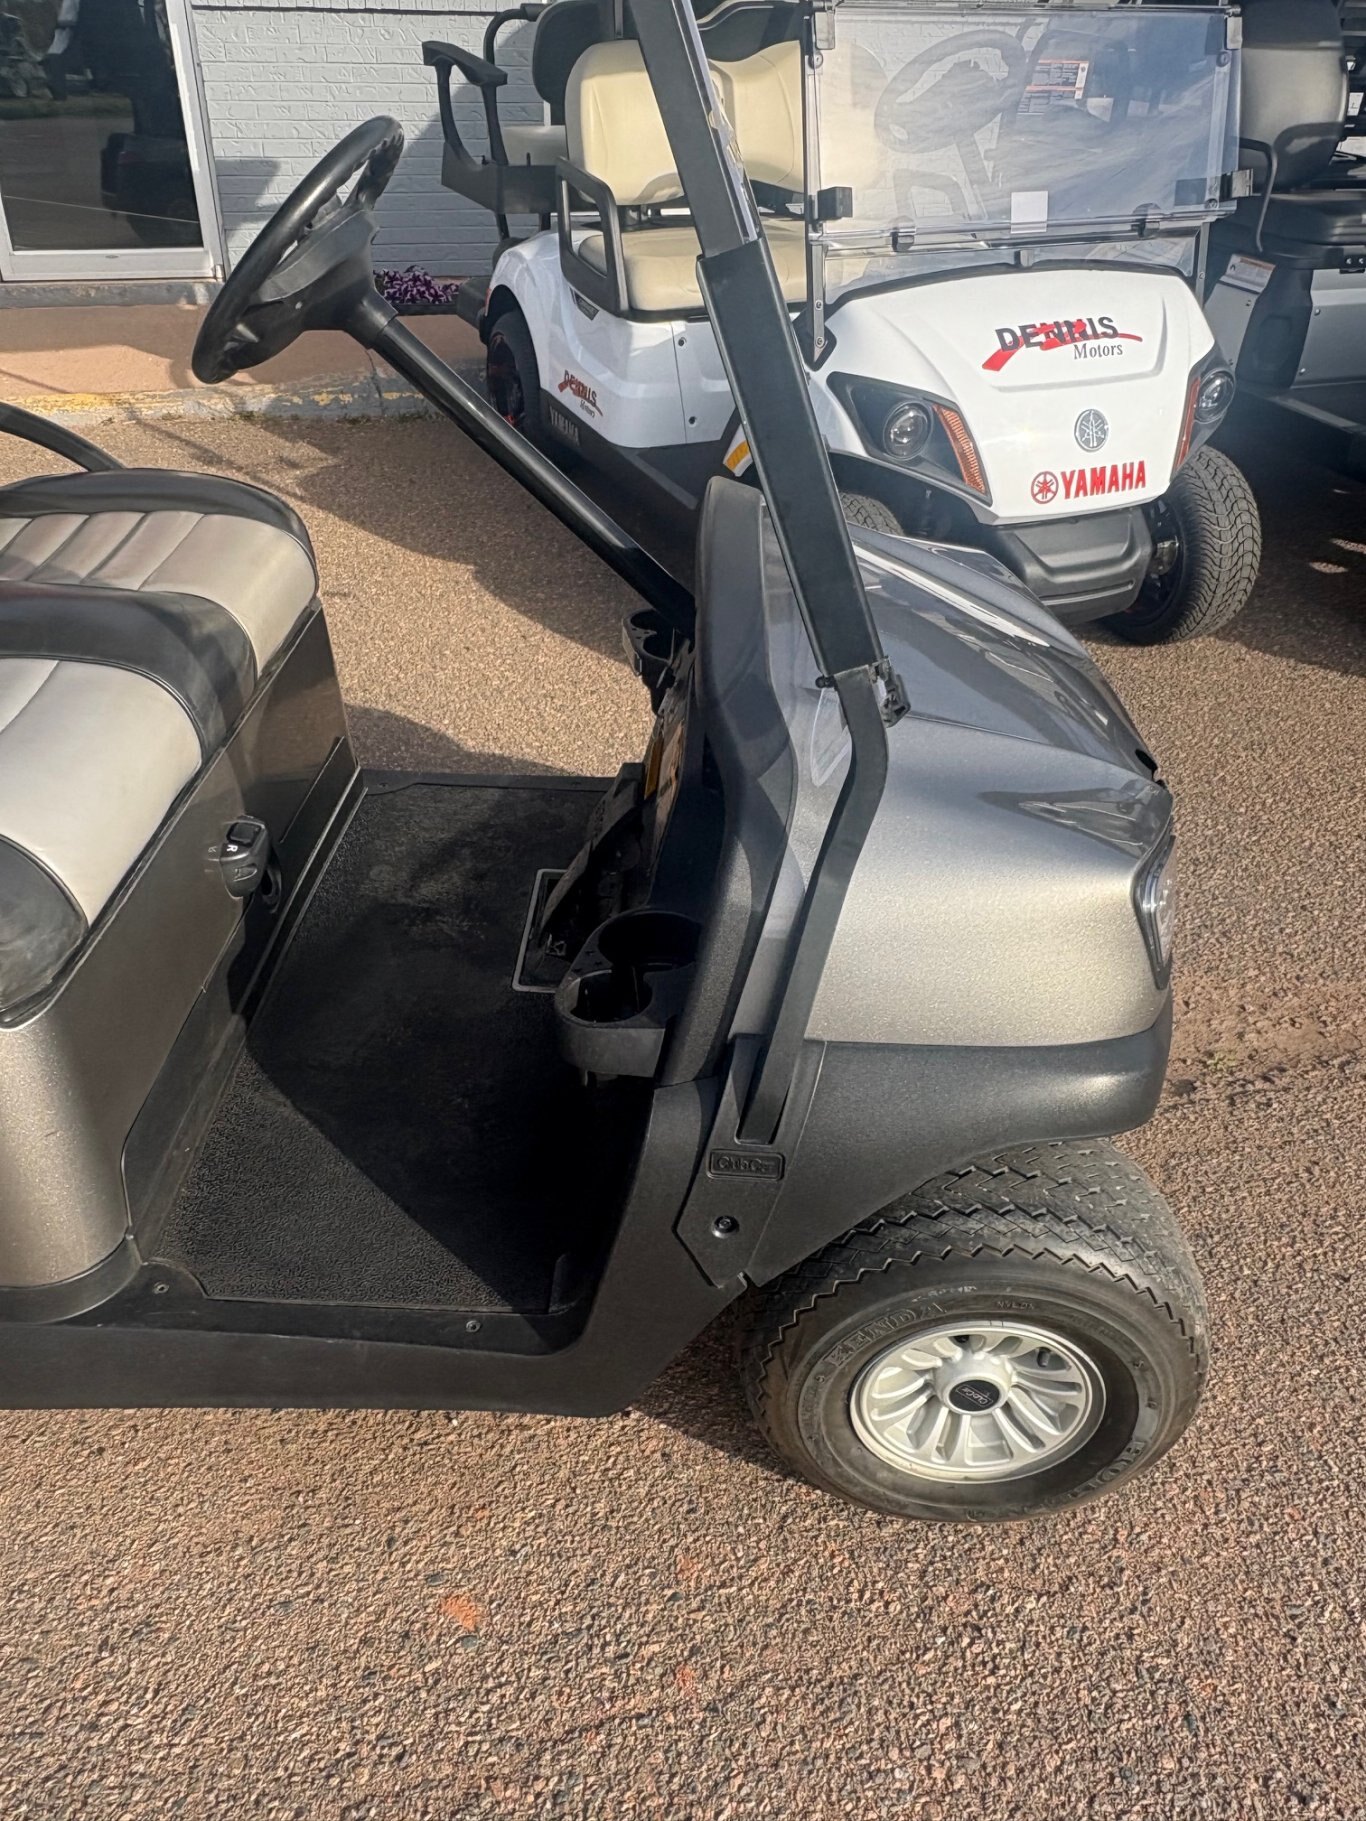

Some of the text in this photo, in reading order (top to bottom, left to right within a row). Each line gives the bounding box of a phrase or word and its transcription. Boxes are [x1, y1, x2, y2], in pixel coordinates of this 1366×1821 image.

[995, 316, 1118, 352] DENNIS
[1073, 343, 1123, 360] Motors
[1060, 460, 1146, 500] YAMAHA
[824, 1301, 947, 1368] KENDA
